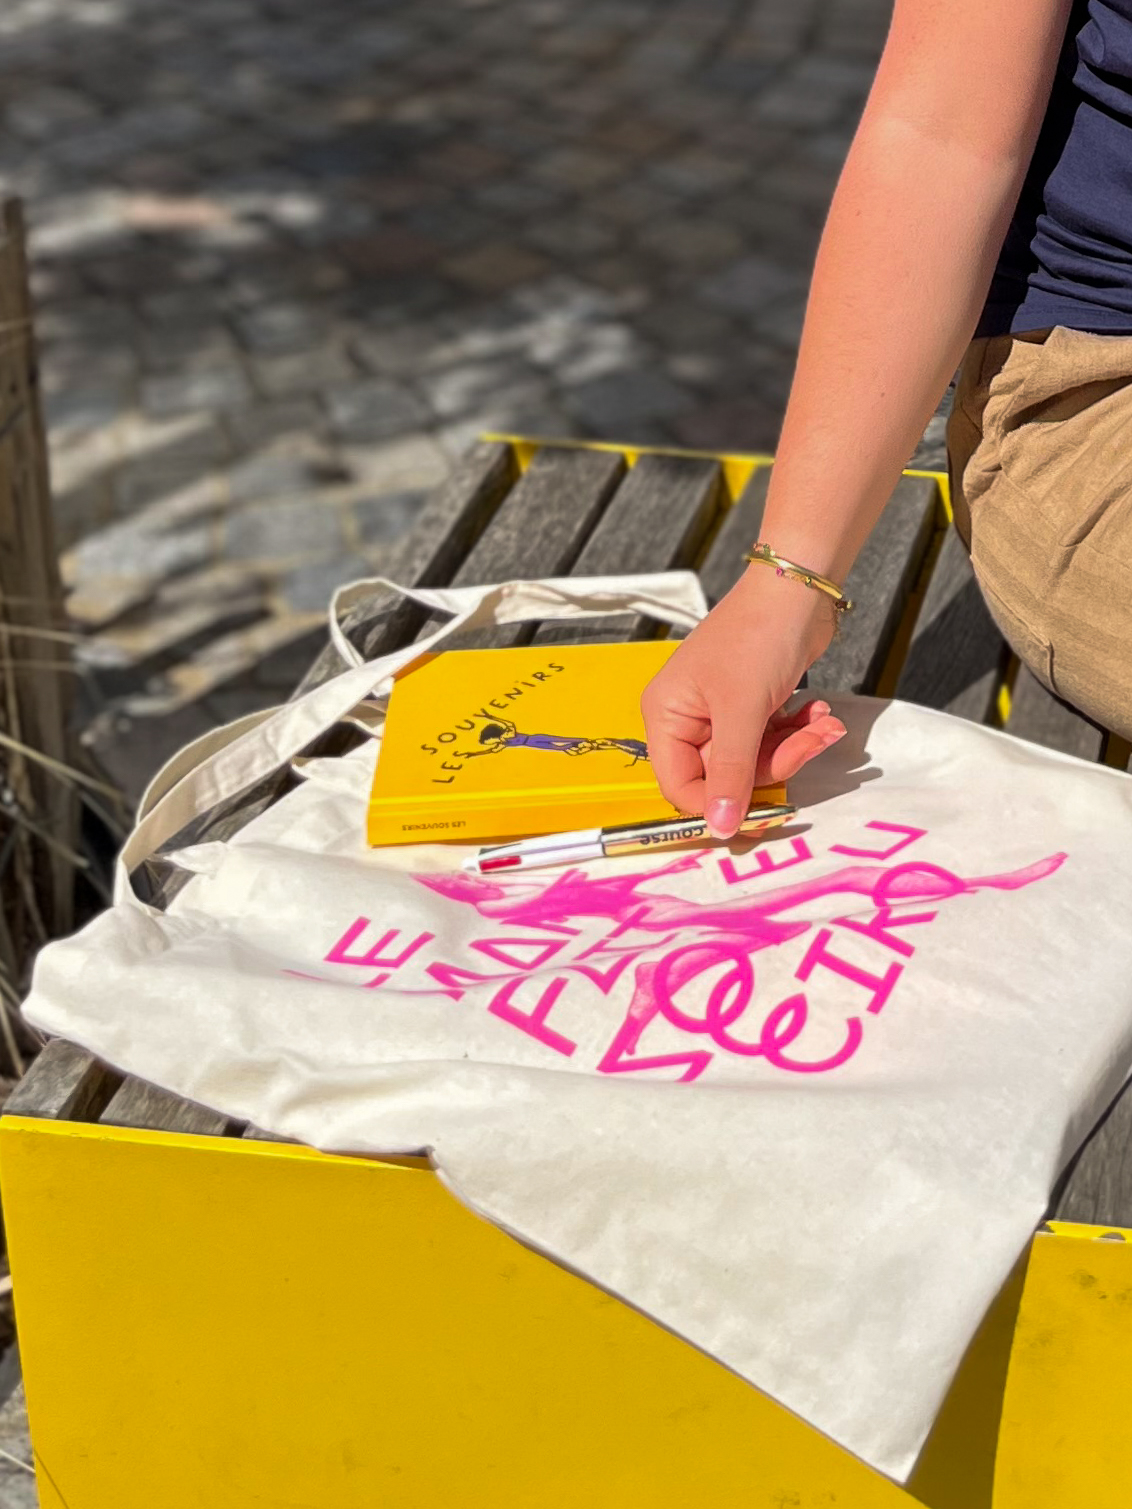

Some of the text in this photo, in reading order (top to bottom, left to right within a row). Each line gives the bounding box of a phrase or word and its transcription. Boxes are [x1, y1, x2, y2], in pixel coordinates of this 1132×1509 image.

[420, 662, 565, 755] SOUVENIRS
[431, 749, 470, 784] LES
[451, 820, 466, 828] LES
[640, 824, 705, 846] course
